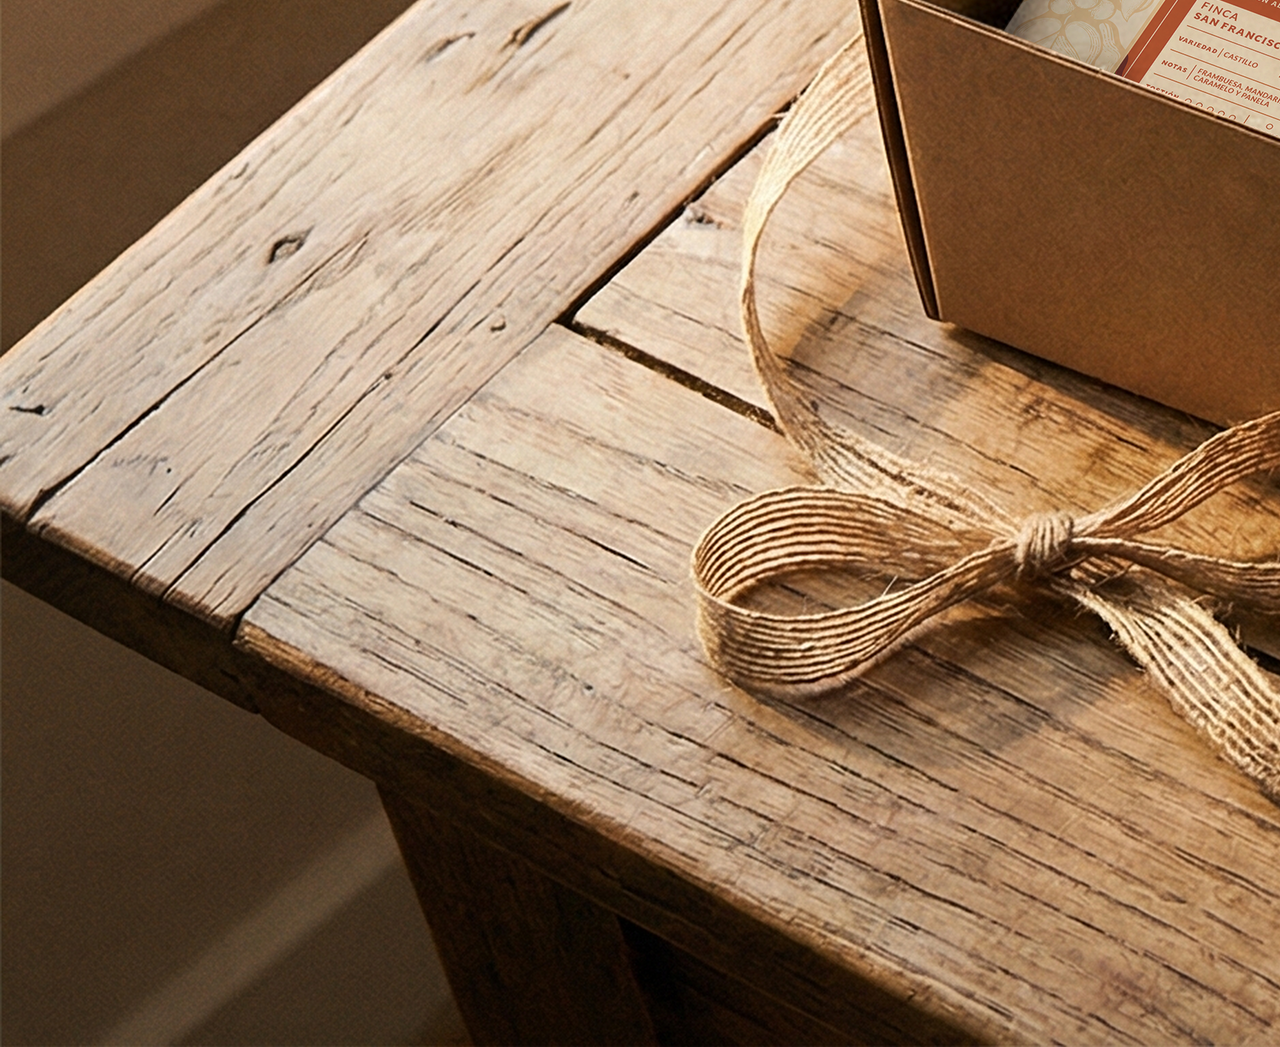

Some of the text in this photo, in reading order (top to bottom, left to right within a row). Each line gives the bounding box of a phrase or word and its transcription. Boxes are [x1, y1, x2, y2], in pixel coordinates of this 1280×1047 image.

[1193, 12, 1220, 27] SAN
[1200, 1, 1239, 21] FINCA
[1178, 35, 1259, 69] VARIEDAD CASTILLO
[1161, 59, 1188, 73] NOTAS
[1197, 68, 1244, 90] FRAMBUESA,
[1193, 75, 1235, 93] CARAMELO
[1240, 93, 1270, 107] PANELA
